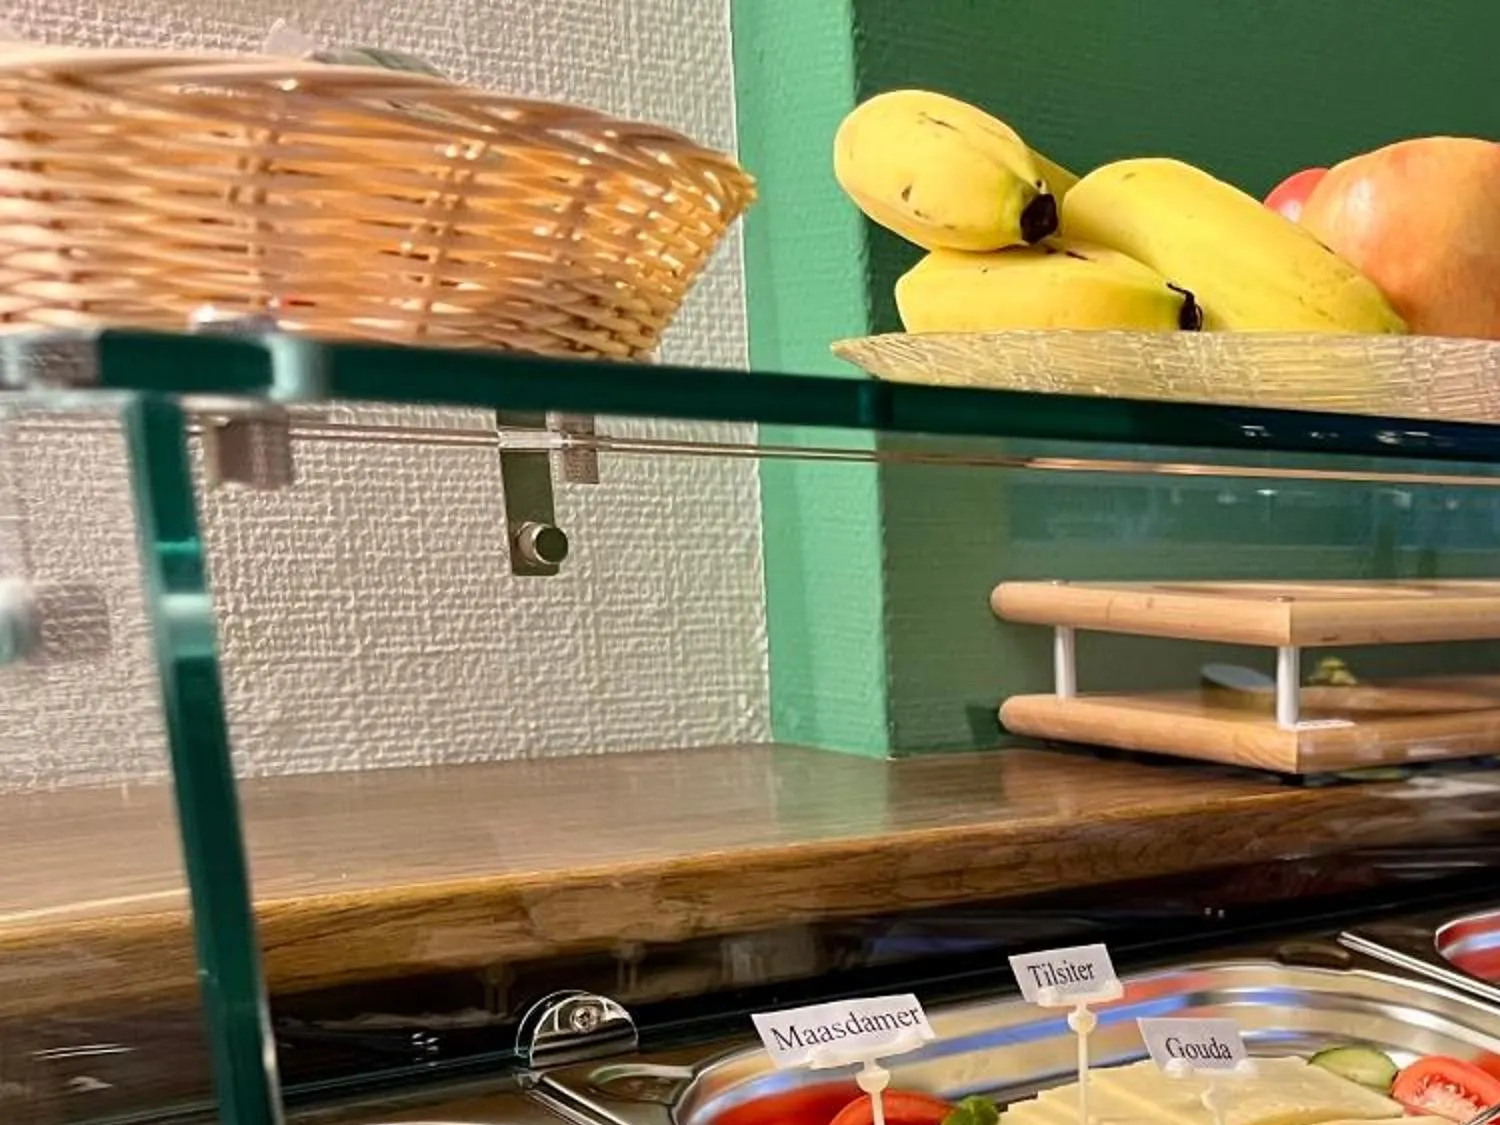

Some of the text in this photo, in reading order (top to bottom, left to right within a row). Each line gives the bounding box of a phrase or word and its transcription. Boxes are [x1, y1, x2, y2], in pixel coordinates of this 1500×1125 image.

[1026, 959, 1096, 989] Tilsiter
[770, 1005, 923, 1052] Maasdamer
[1165, 1035, 1233, 1062] Gouda
